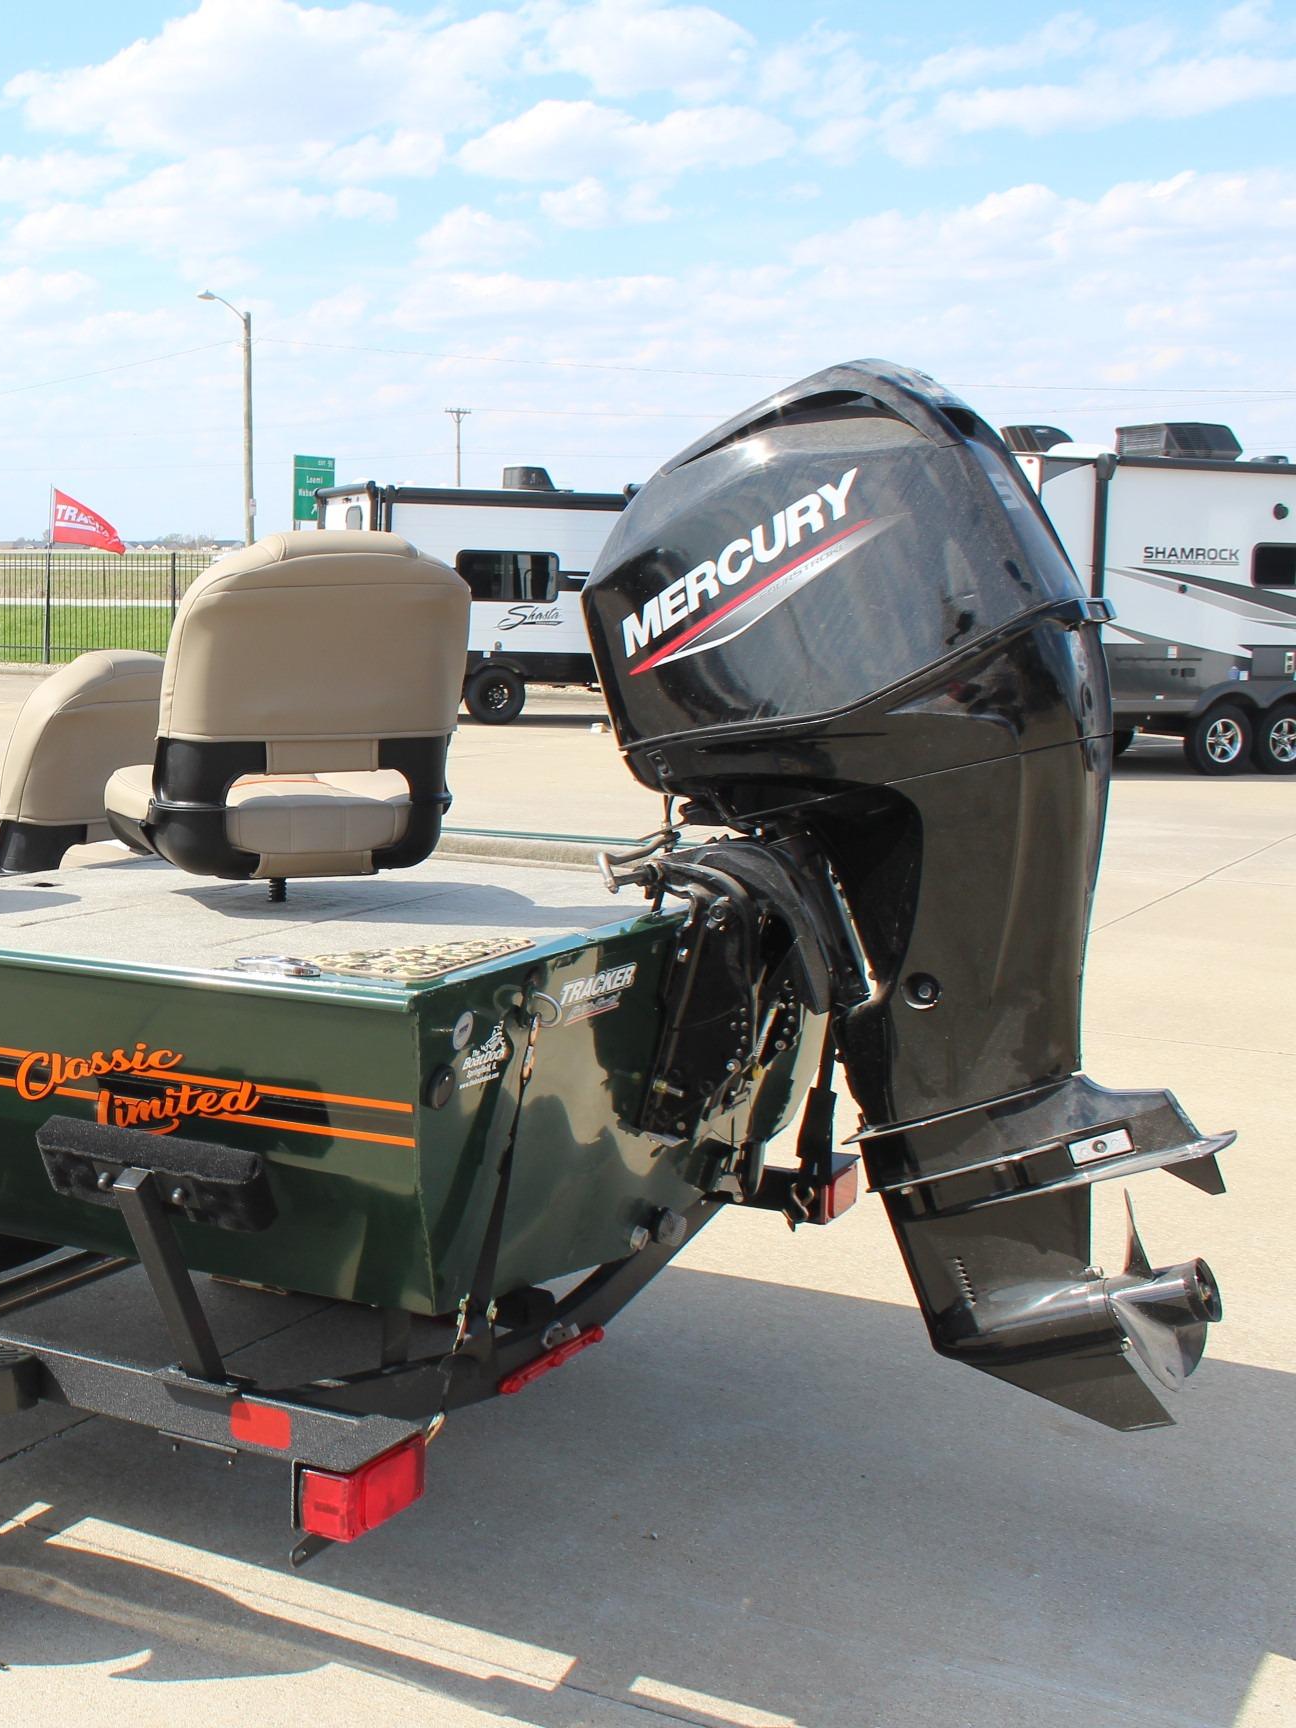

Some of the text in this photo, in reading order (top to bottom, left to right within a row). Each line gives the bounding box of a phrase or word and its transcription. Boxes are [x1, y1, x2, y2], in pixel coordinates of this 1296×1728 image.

[622, 467, 859, 659] MERCURY
[1143, 546, 1240, 561] SHAMROCK
[492, 605, 563, 631] Shasta
[560, 964, 636, 1006] TRACKER
[15, 1042, 184, 1101] Classic
[96, 1080, 261, 1136] Limited
